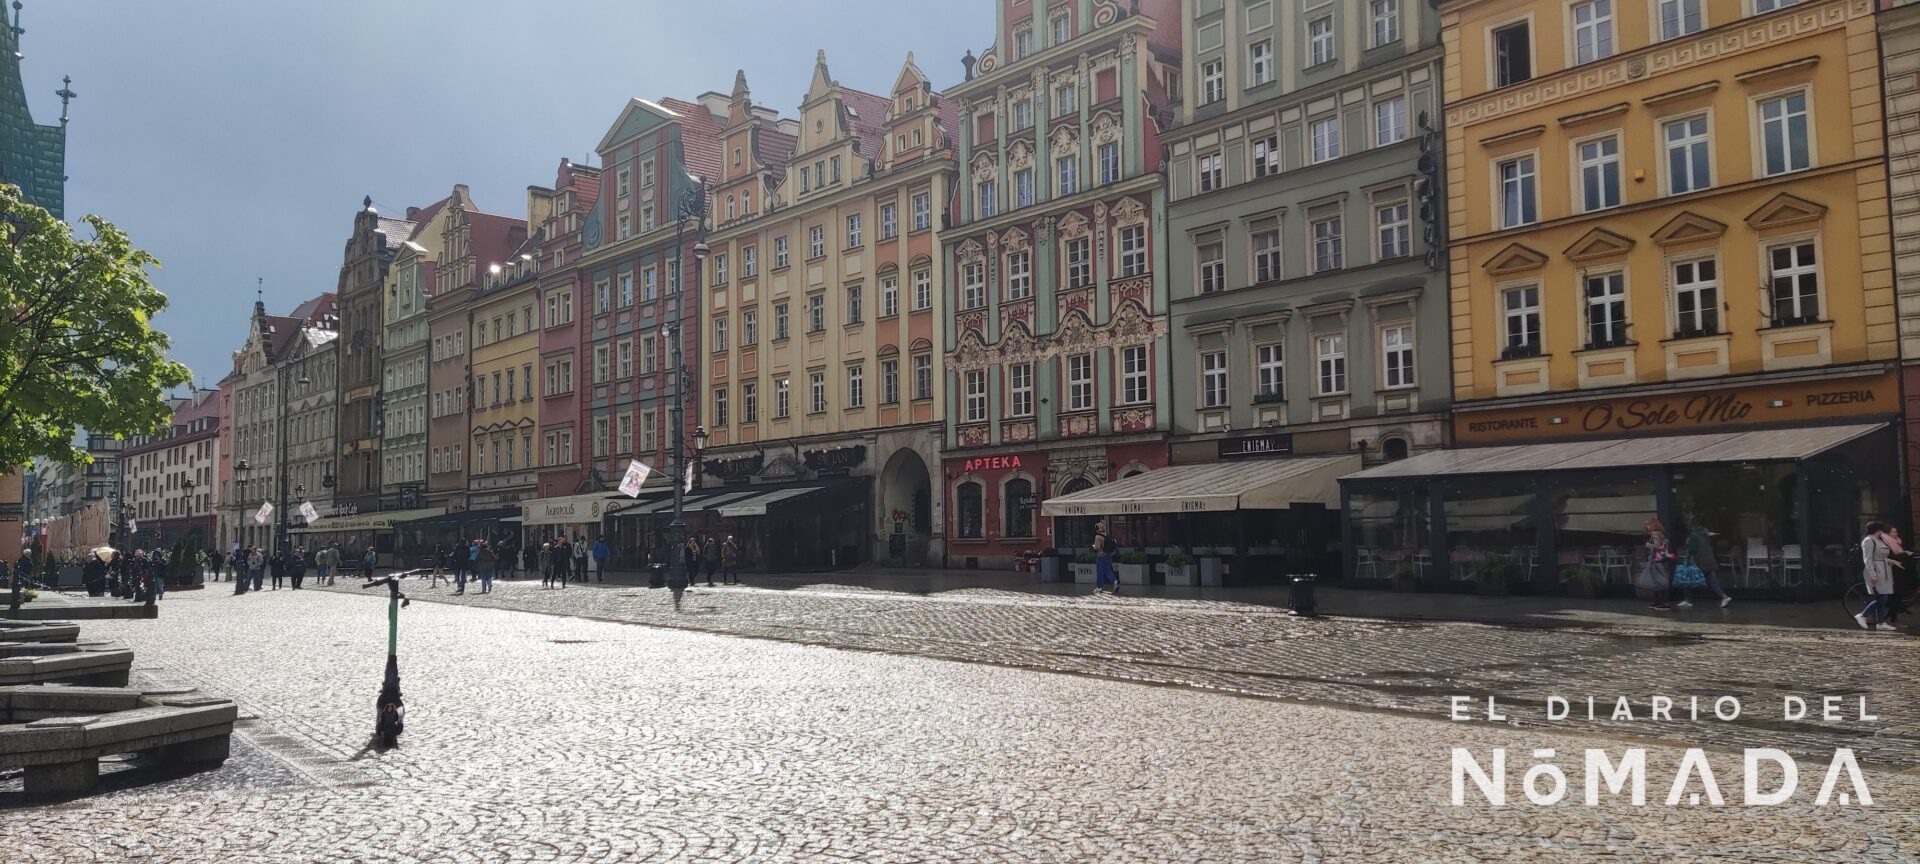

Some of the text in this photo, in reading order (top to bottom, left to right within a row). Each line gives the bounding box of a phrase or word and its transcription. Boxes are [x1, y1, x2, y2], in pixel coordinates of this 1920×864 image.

[1806, 389, 1876, 406] PIZZERIA
[1617, 400, 1679, 430] Sole
[1684, 393, 1753, 422] Mio
[1469, 416, 1539, 433] RISTORANTE
[965, 455, 1022, 471] APTEKA
[545, 503, 576, 516] AKROPOLIS
